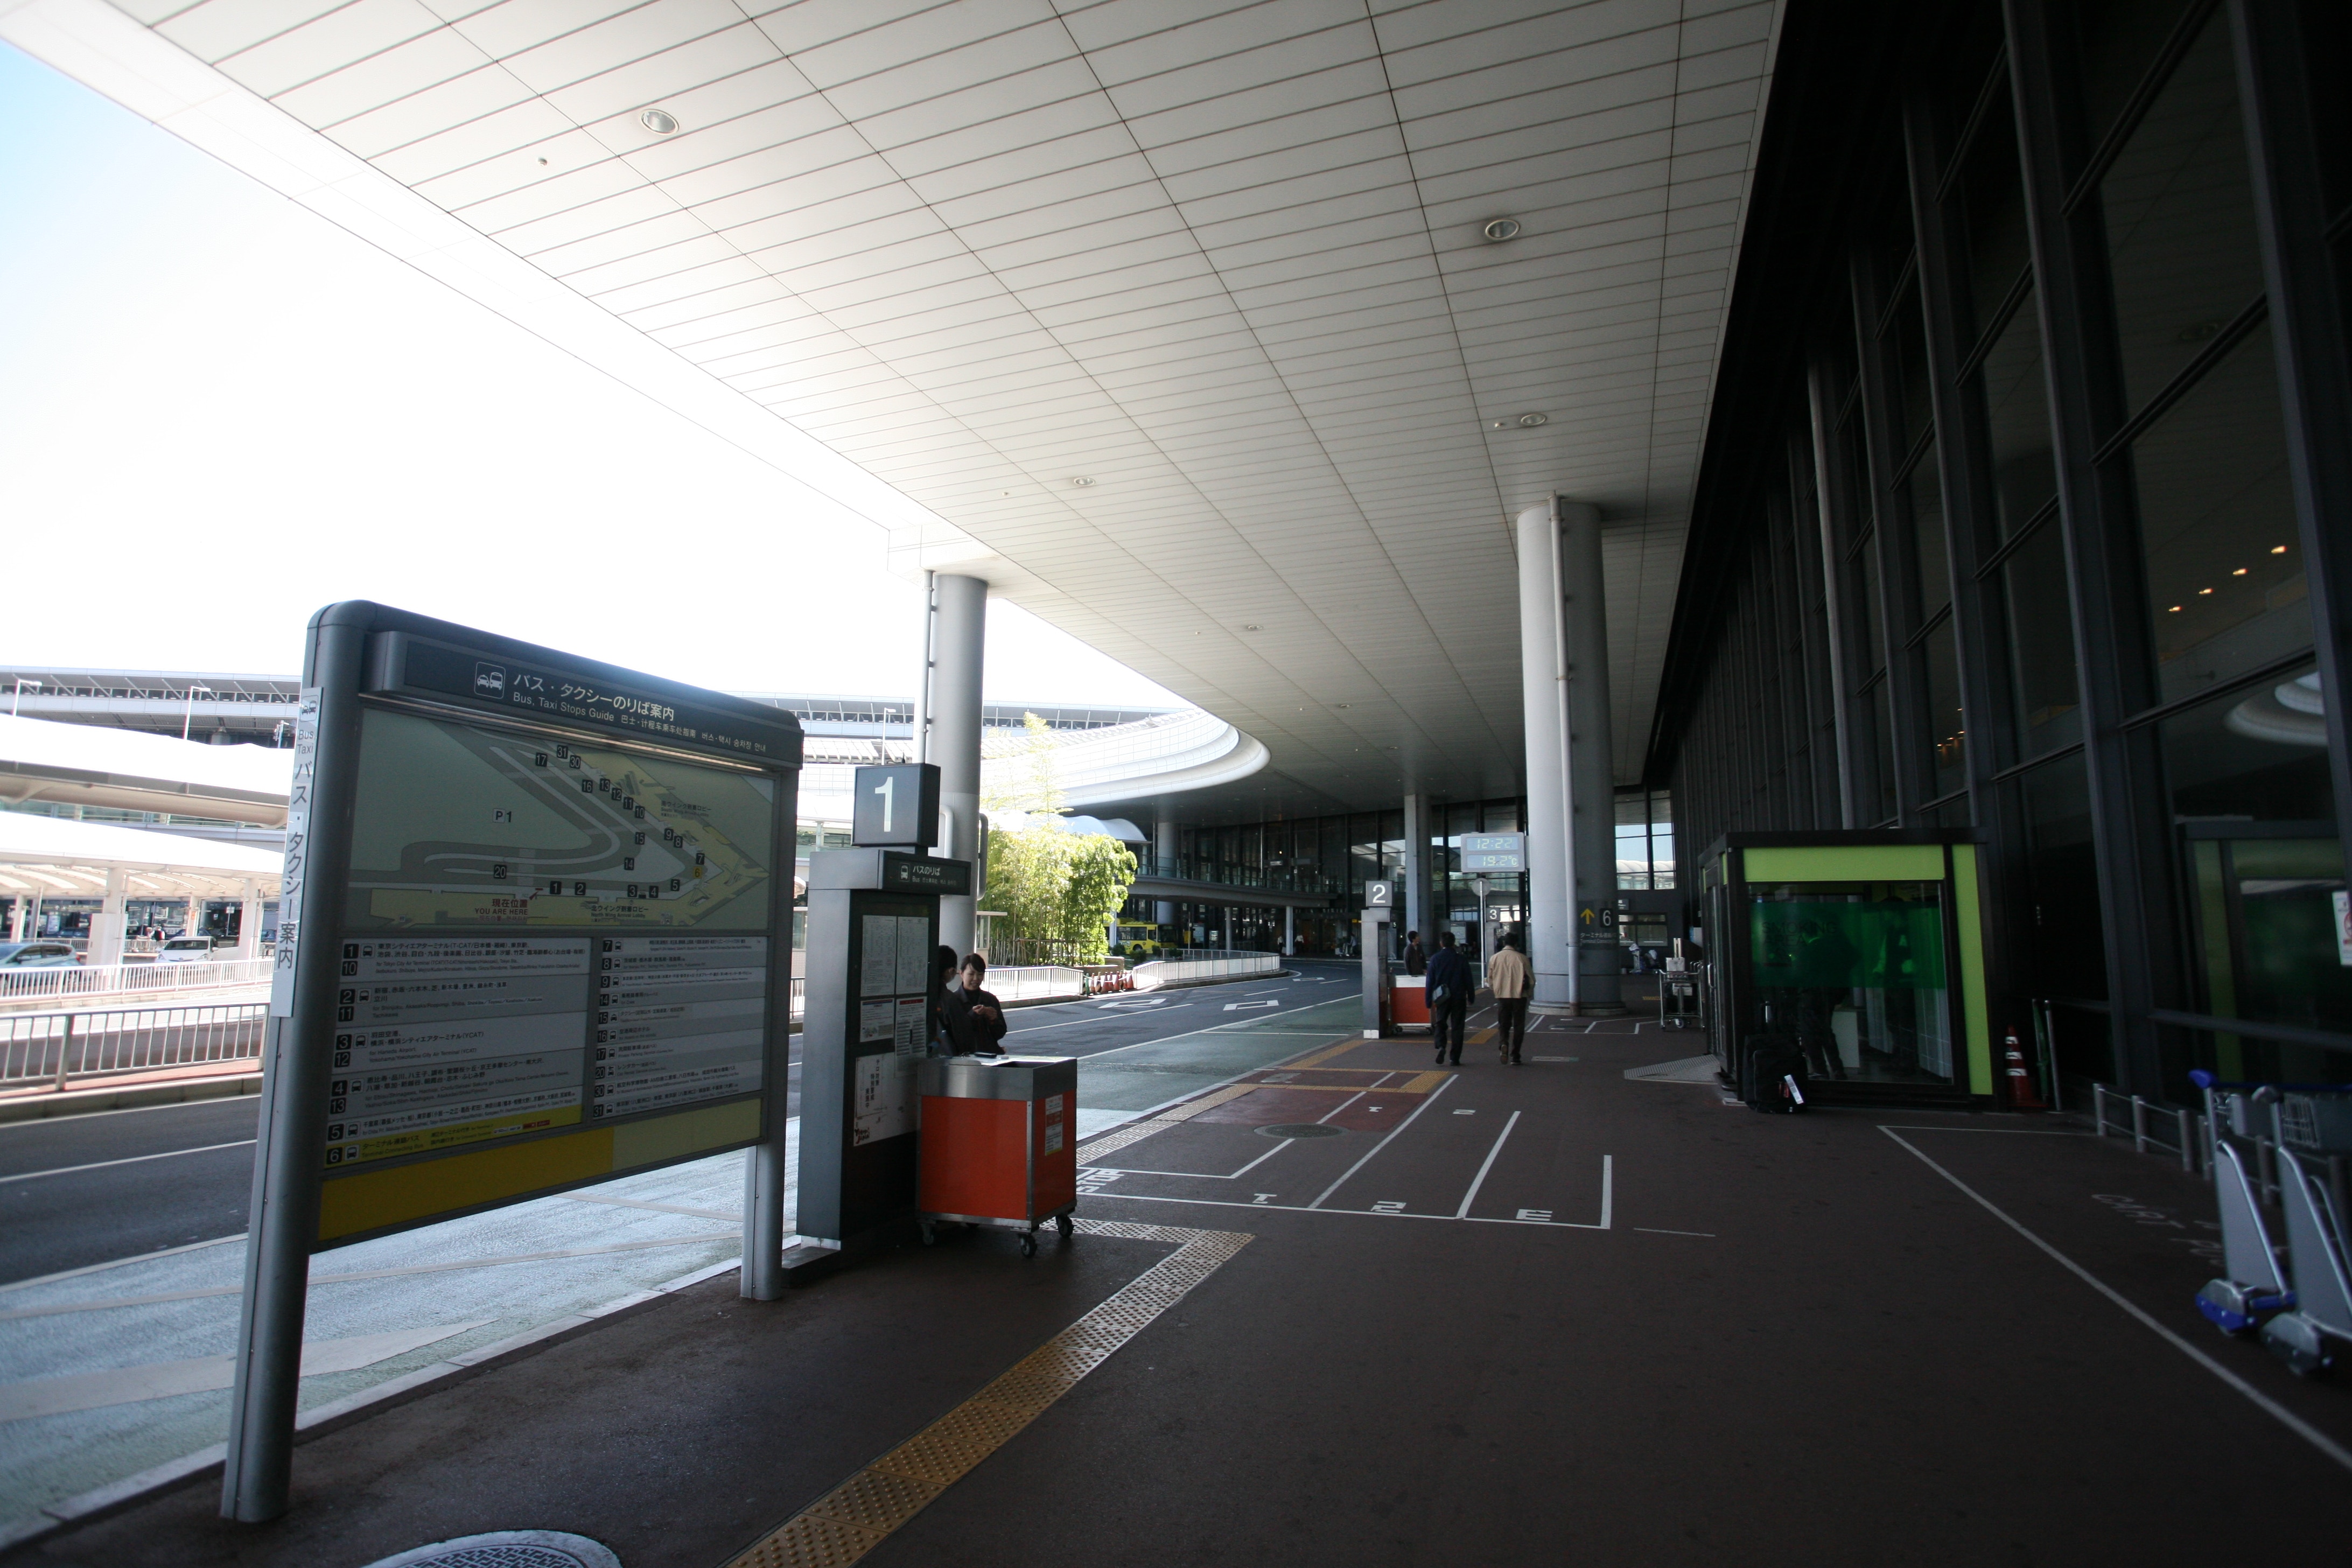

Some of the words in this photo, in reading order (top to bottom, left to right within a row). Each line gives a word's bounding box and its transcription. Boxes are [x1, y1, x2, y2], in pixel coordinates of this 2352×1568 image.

[513, 674, 674, 720] バス・タクシーのりば案内
[513, 692, 535, 706] Bus,
[538, 697, 558, 710] Taxi
[561, 702, 586, 716] Stops
[589, 708, 614, 722] Guide
[297, 743, 313, 754] Taxi
[558, 747, 567, 757] 31
[536, 755, 547, 765] 17
[570, 757, 580, 767] 30
[582, 781, 592, 792] 16
[601, 780, 610, 790] 13
[612, 789, 621, 799] 12
[624, 799, 633, 809] 11
[874, 776, 893, 832] 1
[635, 808, 645, 817] 10
[636, 834, 645, 844] 15
[666, 830, 672, 839] 9
[675, 837, 682, 847] 8
[1477, 838, 1513, 849] 12:22
[697, 854, 703, 863] 7
[625, 859, 634, 869] 14
[494, 866, 506, 877] 20
[695, 868, 701, 877] 6
[913, 866, 941, 876] バスのりば
[553, 884, 558, 893] 1
[577, 884, 583, 894] 2
[673, 880, 678, 890] 5
[629, 886, 636, 896] 3
[650, 887, 657, 897] 4
[1373, 884, 1386, 904] 2
[1489, 909, 1497, 920] 3
[1602, 909, 1612, 926] 6
[605, 941, 611, 950] 7
[347, 945, 354, 957] 1
[343, 962, 356, 975] 10
[603, 959, 610, 969] 8
[602, 977, 608, 987] 9
[342, 990, 352, 1003] 2
[600, 995, 608, 1005] 14
[340, 1008, 352, 1020] 11
[599, 1013, 608, 1023] 15
[598, 1031, 607, 1041] 16
[340, 1037, 348, 1048] 3
[336, 1053, 349, 1066] 12
[597, 1049, 606, 1060] 17
[595, 1067, 604, 1078] 20
[335, 1083, 344, 1094] 4
[594, 1086, 604, 1096] 30
[332, 1099, 344, 1112] 13
[593, 1106, 603, 1116] 31
[332, 1126, 340, 1139] 5
[330, 1149, 339, 1161] 6
